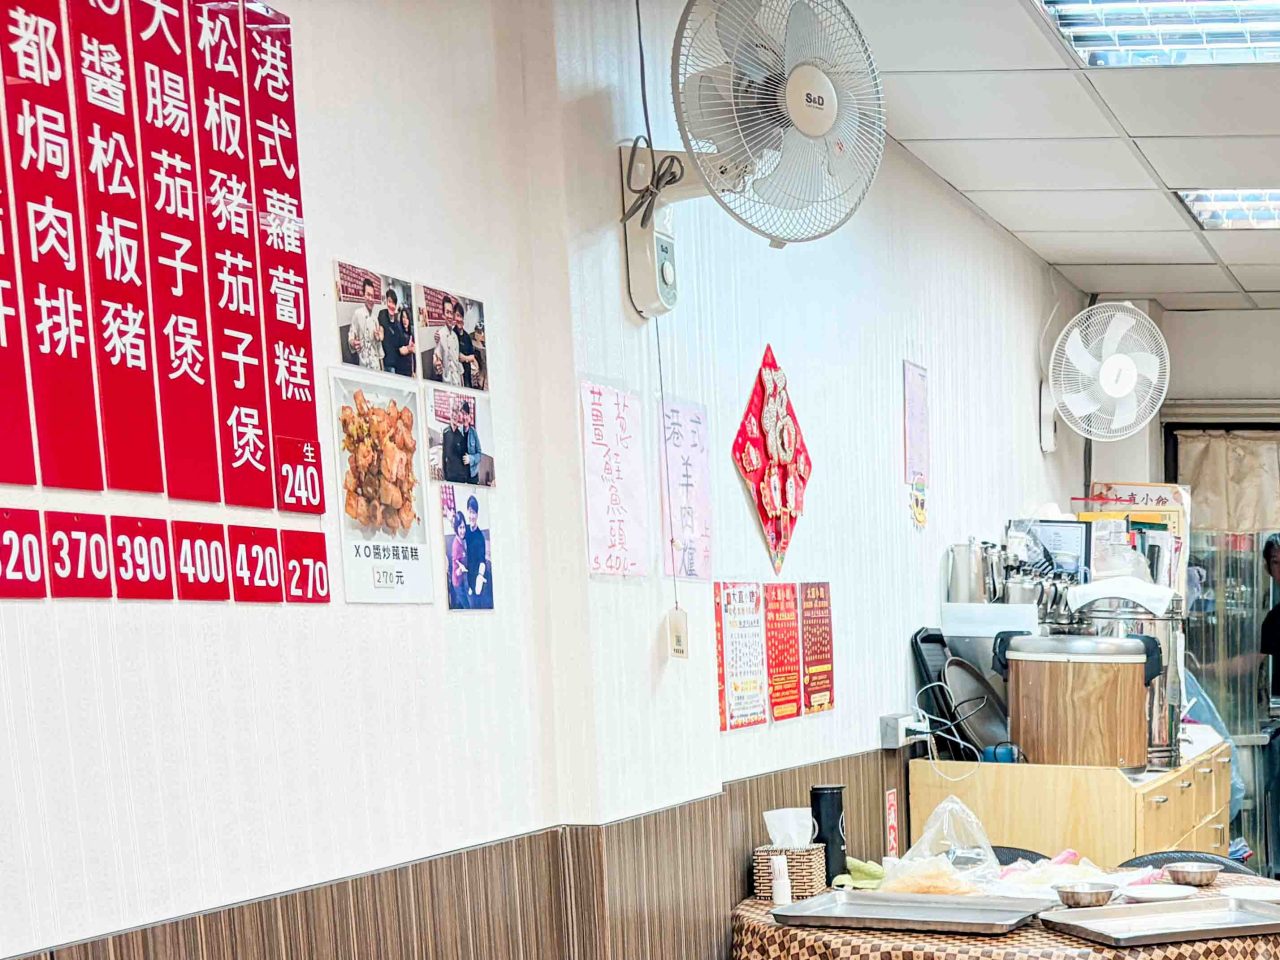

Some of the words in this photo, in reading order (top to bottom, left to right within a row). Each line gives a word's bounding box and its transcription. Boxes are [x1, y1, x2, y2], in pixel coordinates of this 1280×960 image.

[805, 92, 824, 106] S&D
[140, 0, 206, 385] 大腸茄子煲
[250, 31, 312, 402] 港式蘿蔔糕
[196, 5, 267, 472] 松板豬茄子煲
[281, 463, 321, 507] 240
[302, 442, 317, 463] 生
[0, 530, 41, 582] 20
[51, 530, 108, 580] 370
[116, 534, 167, 583] 390
[179, 538, 226, 584] 400
[235, 543, 280, 588] 420
[287, 557, 329, 599] 270
